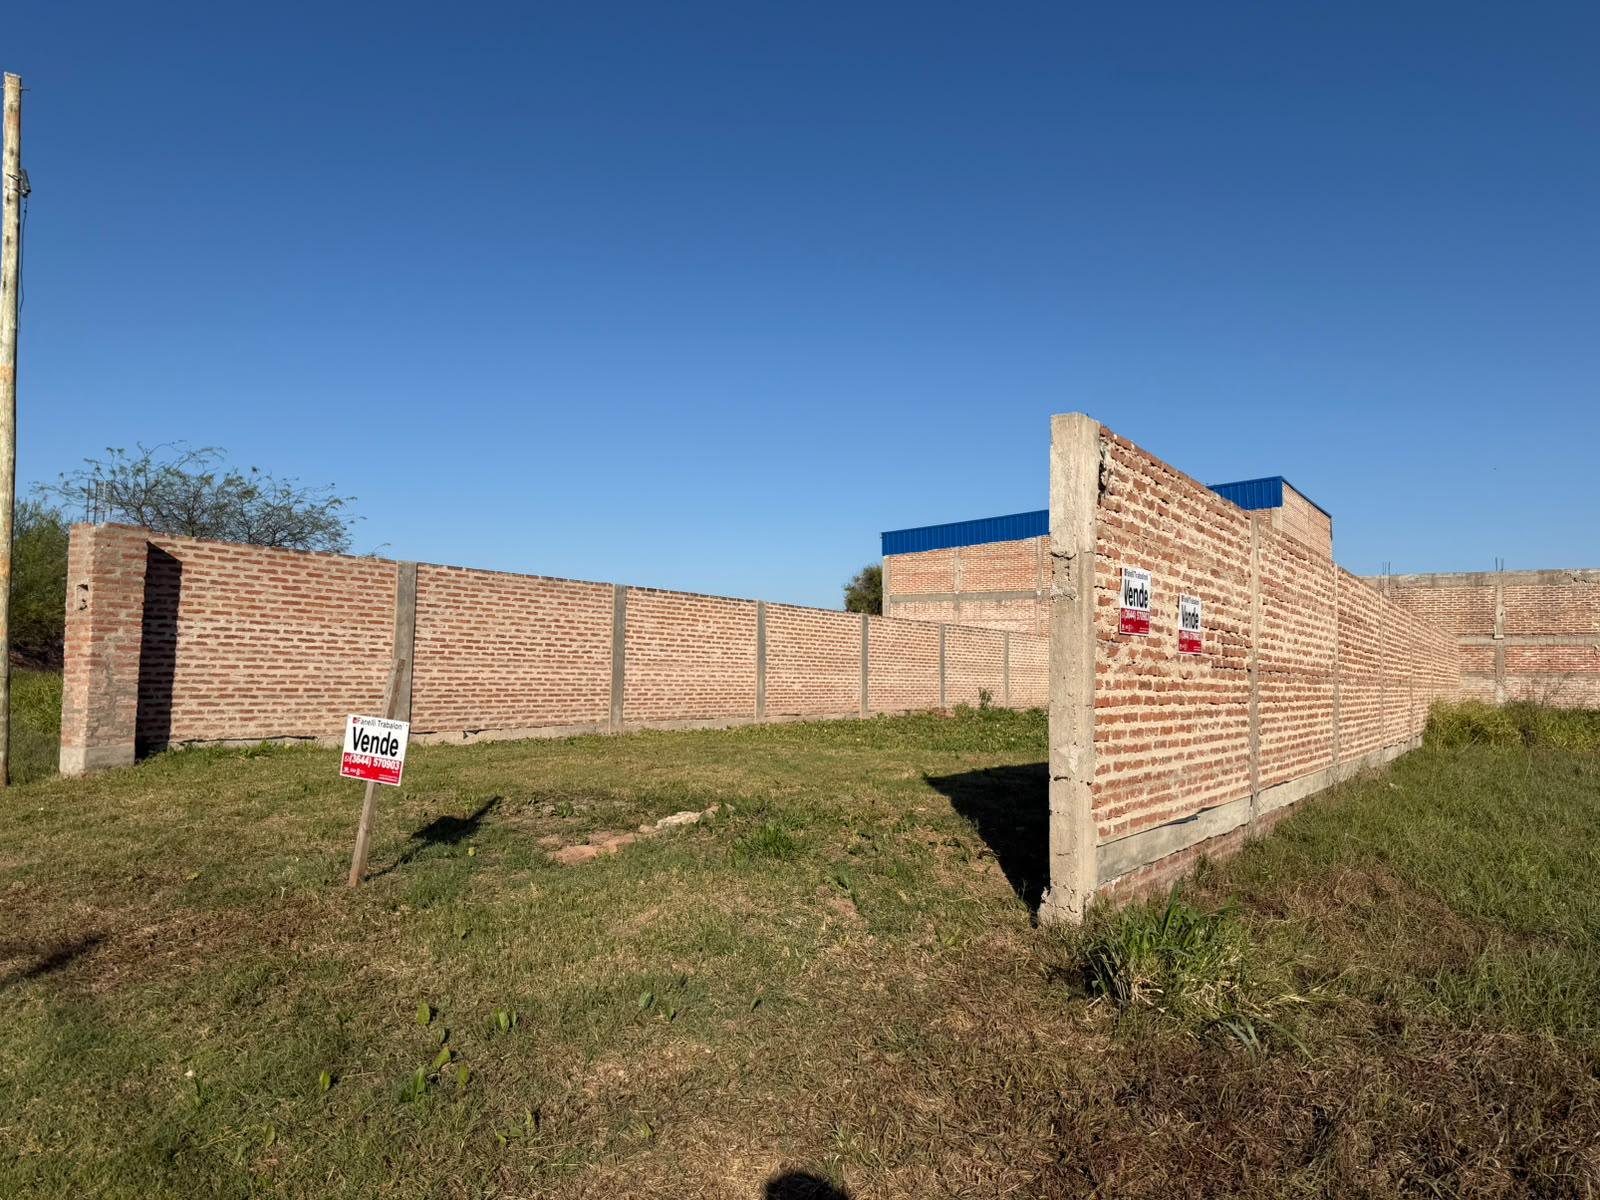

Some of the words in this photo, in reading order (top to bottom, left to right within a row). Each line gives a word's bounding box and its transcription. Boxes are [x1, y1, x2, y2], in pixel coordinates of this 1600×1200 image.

[1124, 579, 1148, 608] Vende
[1181, 605, 1198, 630] Vende
[353, 727, 398, 757] Vende
[349, 754, 372, 768] (3644)
[373, 758, 400, 770] 570903
